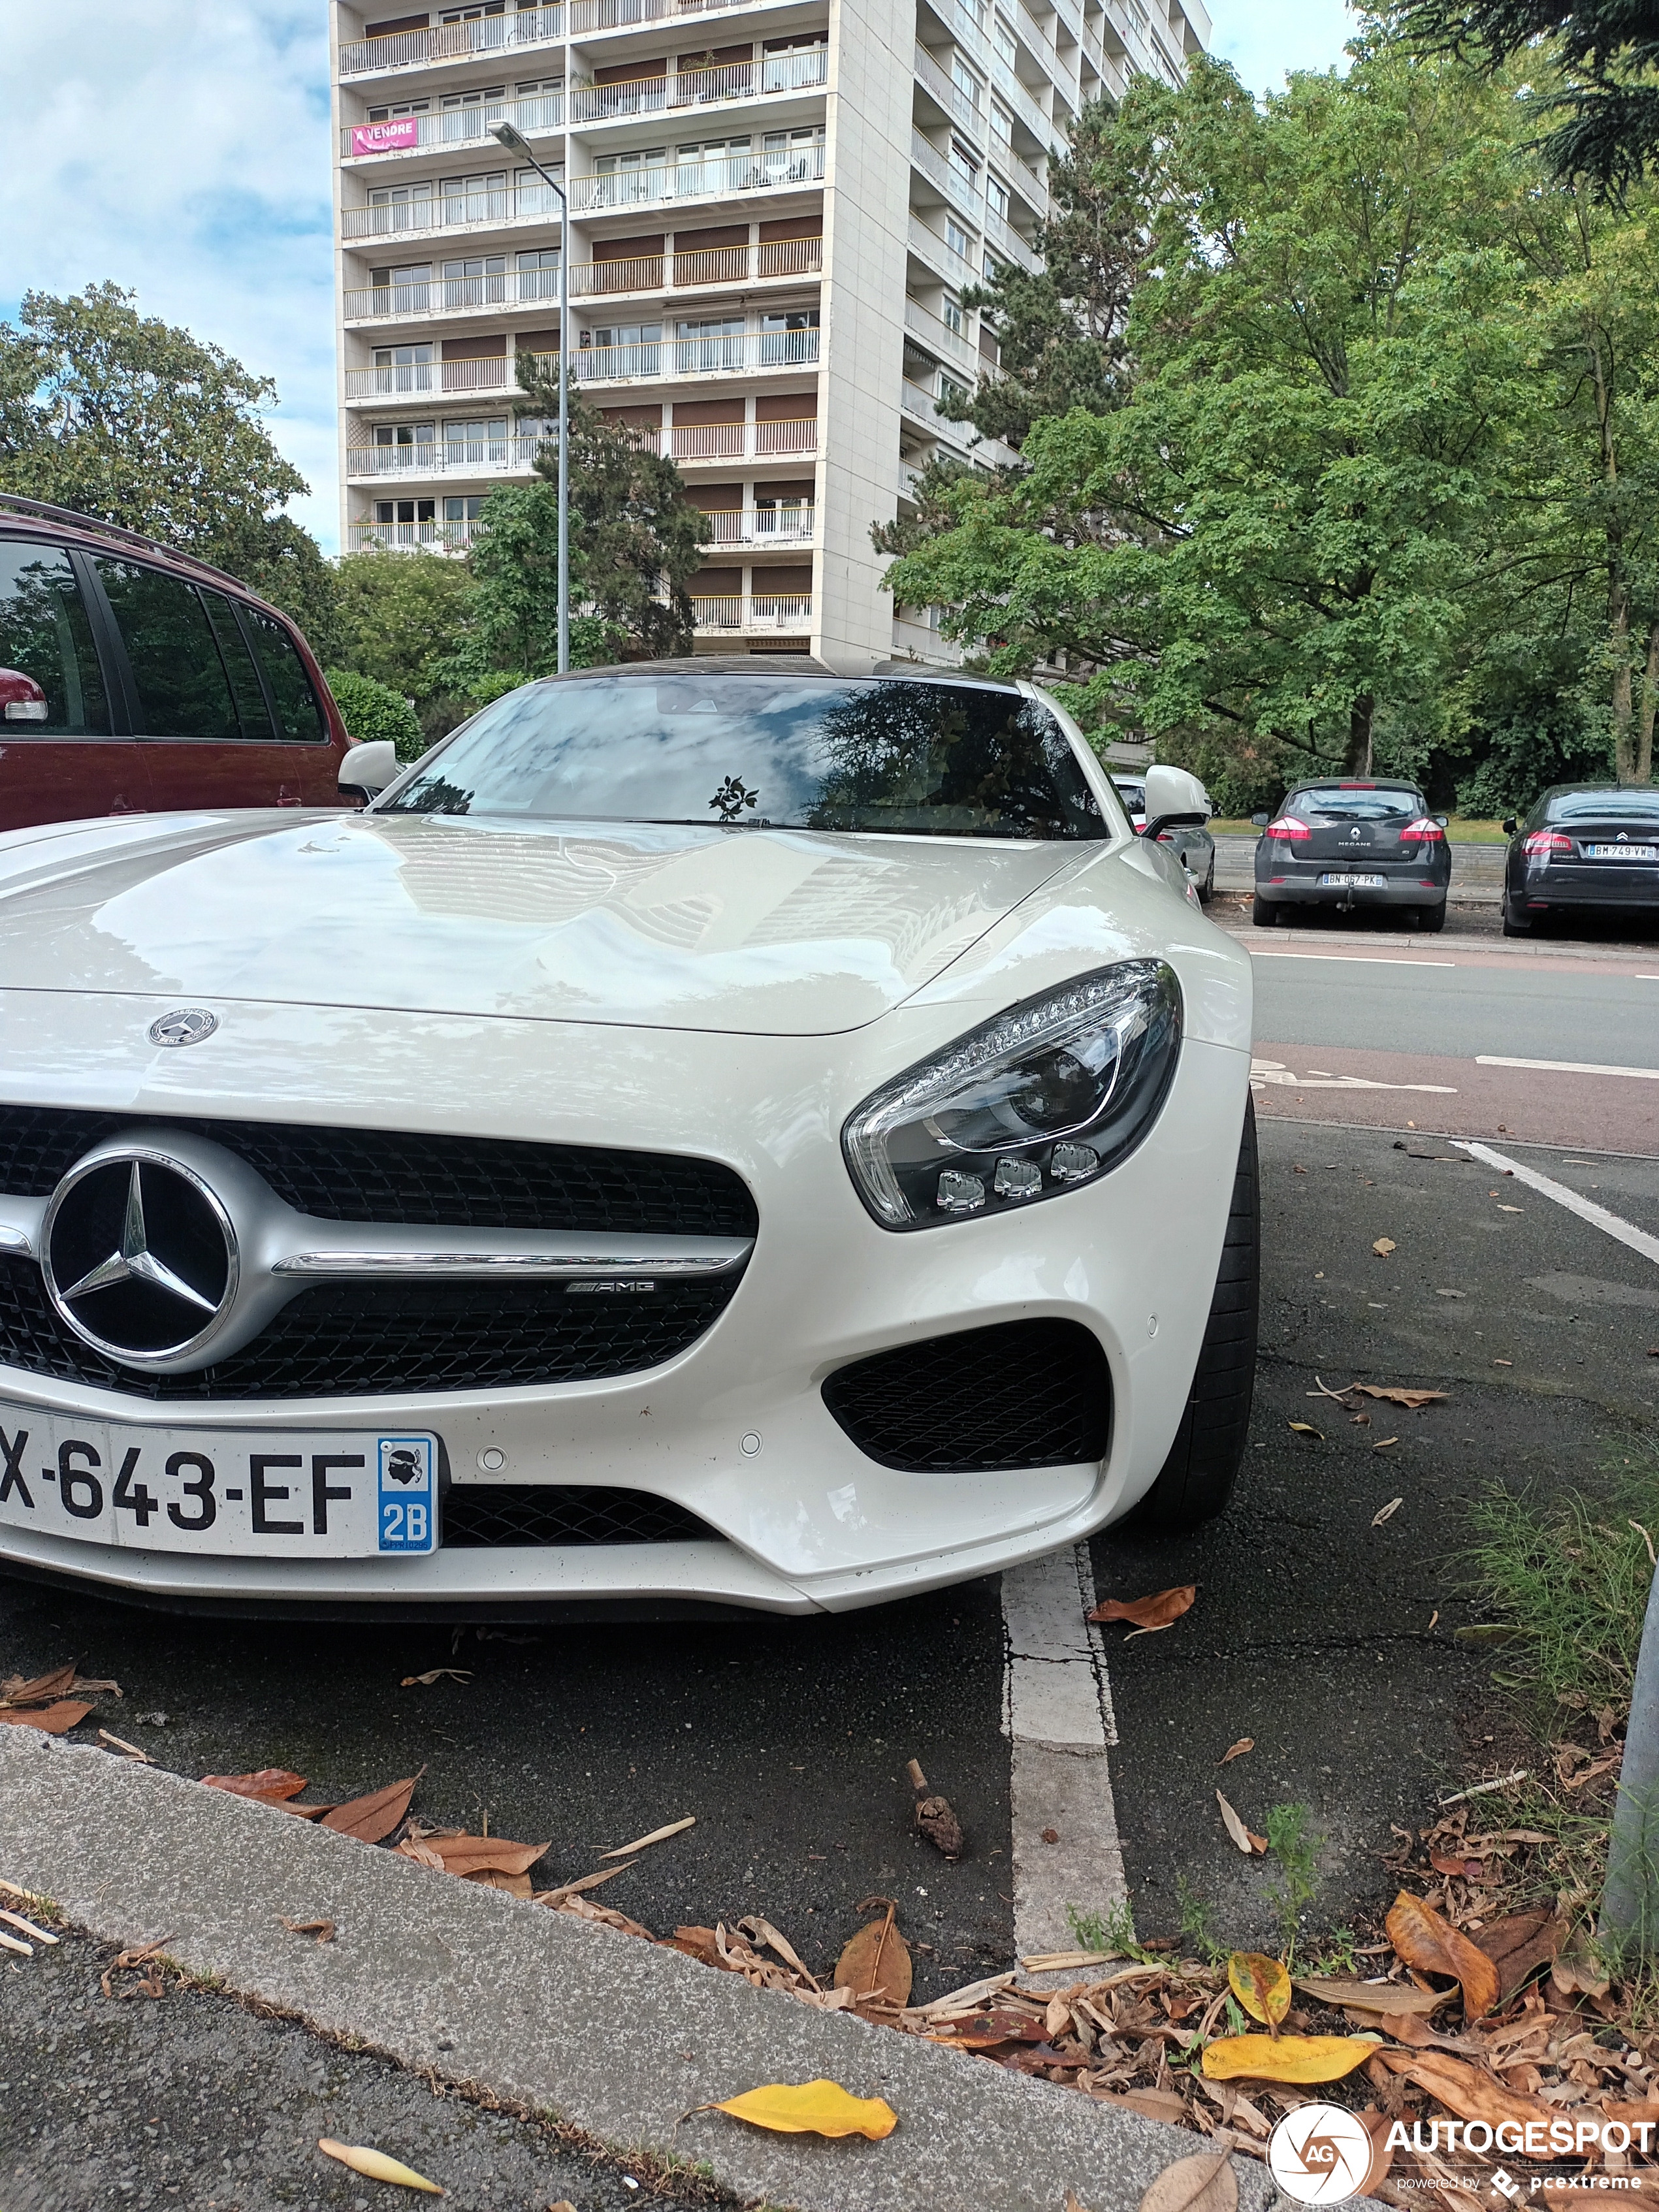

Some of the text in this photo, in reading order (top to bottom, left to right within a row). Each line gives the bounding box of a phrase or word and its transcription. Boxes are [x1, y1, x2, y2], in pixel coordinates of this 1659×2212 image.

[356, 122, 413, 141] A VENDRE
[595, 1282, 654, 1292] AMG
[384, 1503, 427, 1541] 2B
